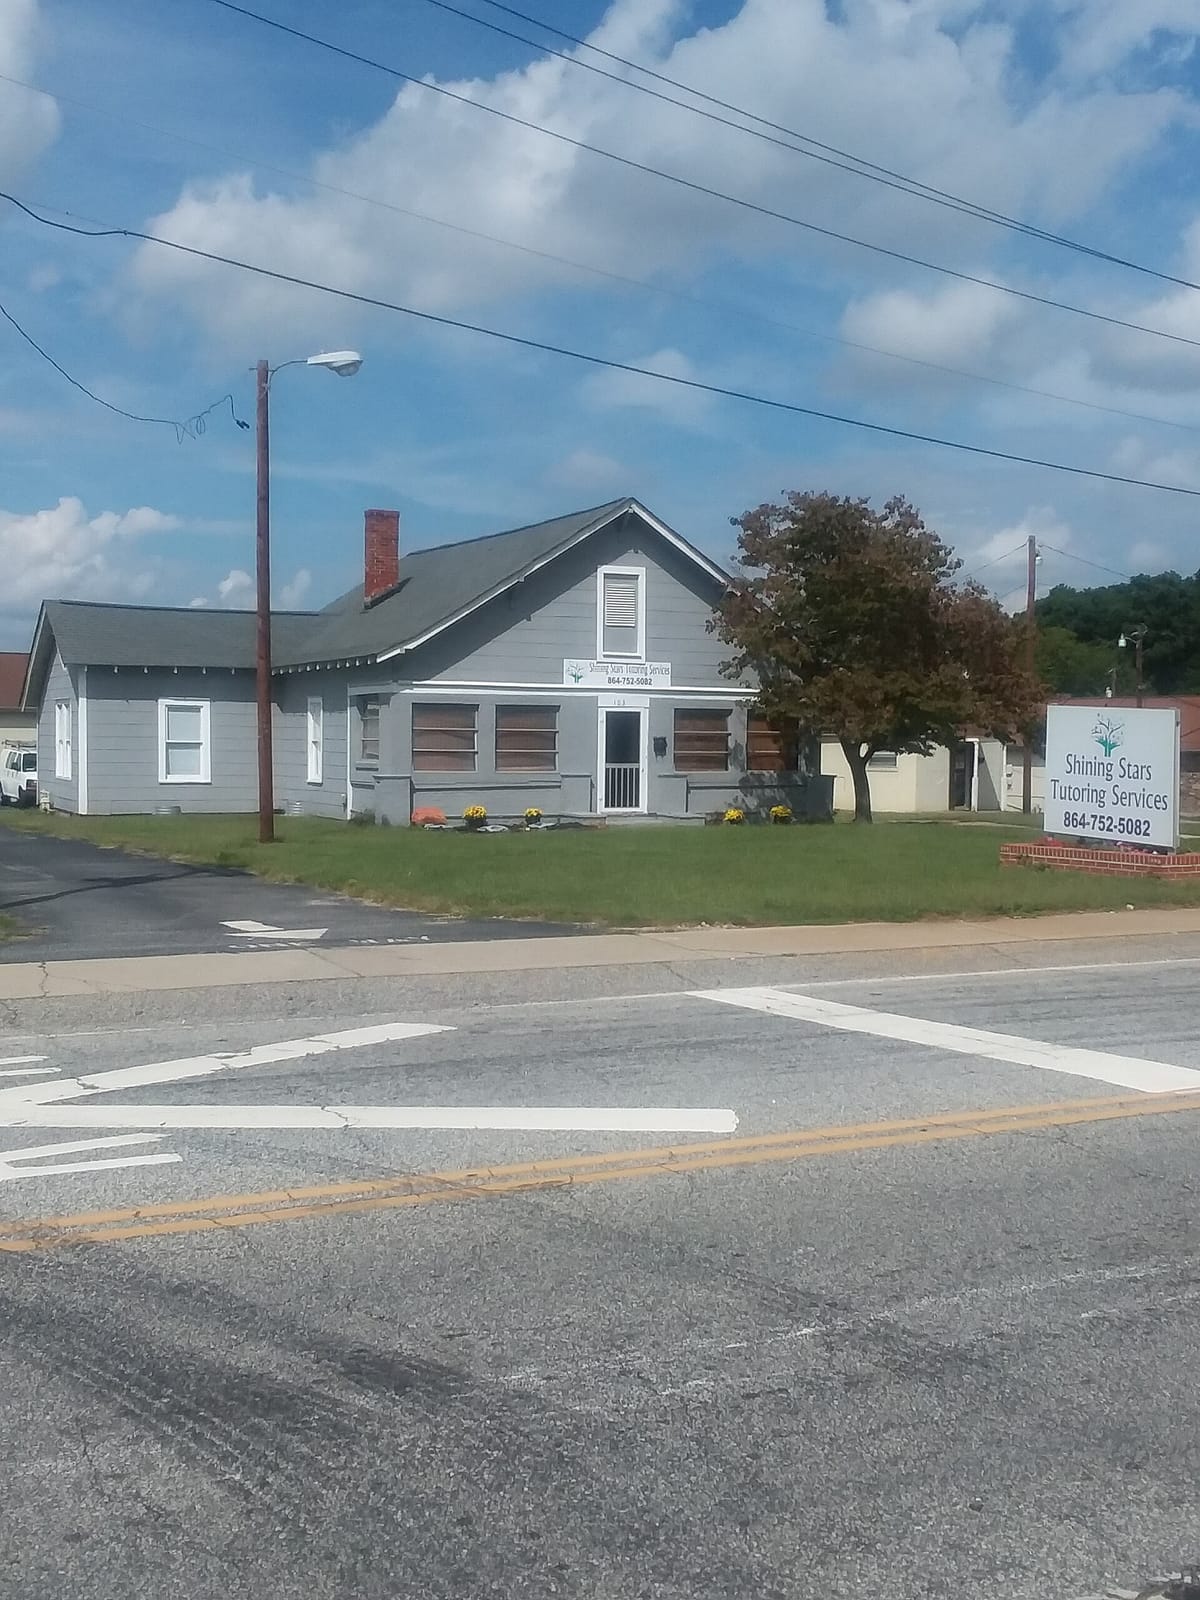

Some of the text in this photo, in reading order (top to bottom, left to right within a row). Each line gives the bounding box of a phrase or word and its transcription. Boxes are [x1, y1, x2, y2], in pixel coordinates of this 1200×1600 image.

[607, 676, 653, 686] 864-752-5082
[649, 664, 670, 676] Services
[1065, 753, 1152, 782] Shining Stars
[1050, 779, 1168, 811] Tutoring Services
[1063, 811, 1151, 837] 864-752-5082
